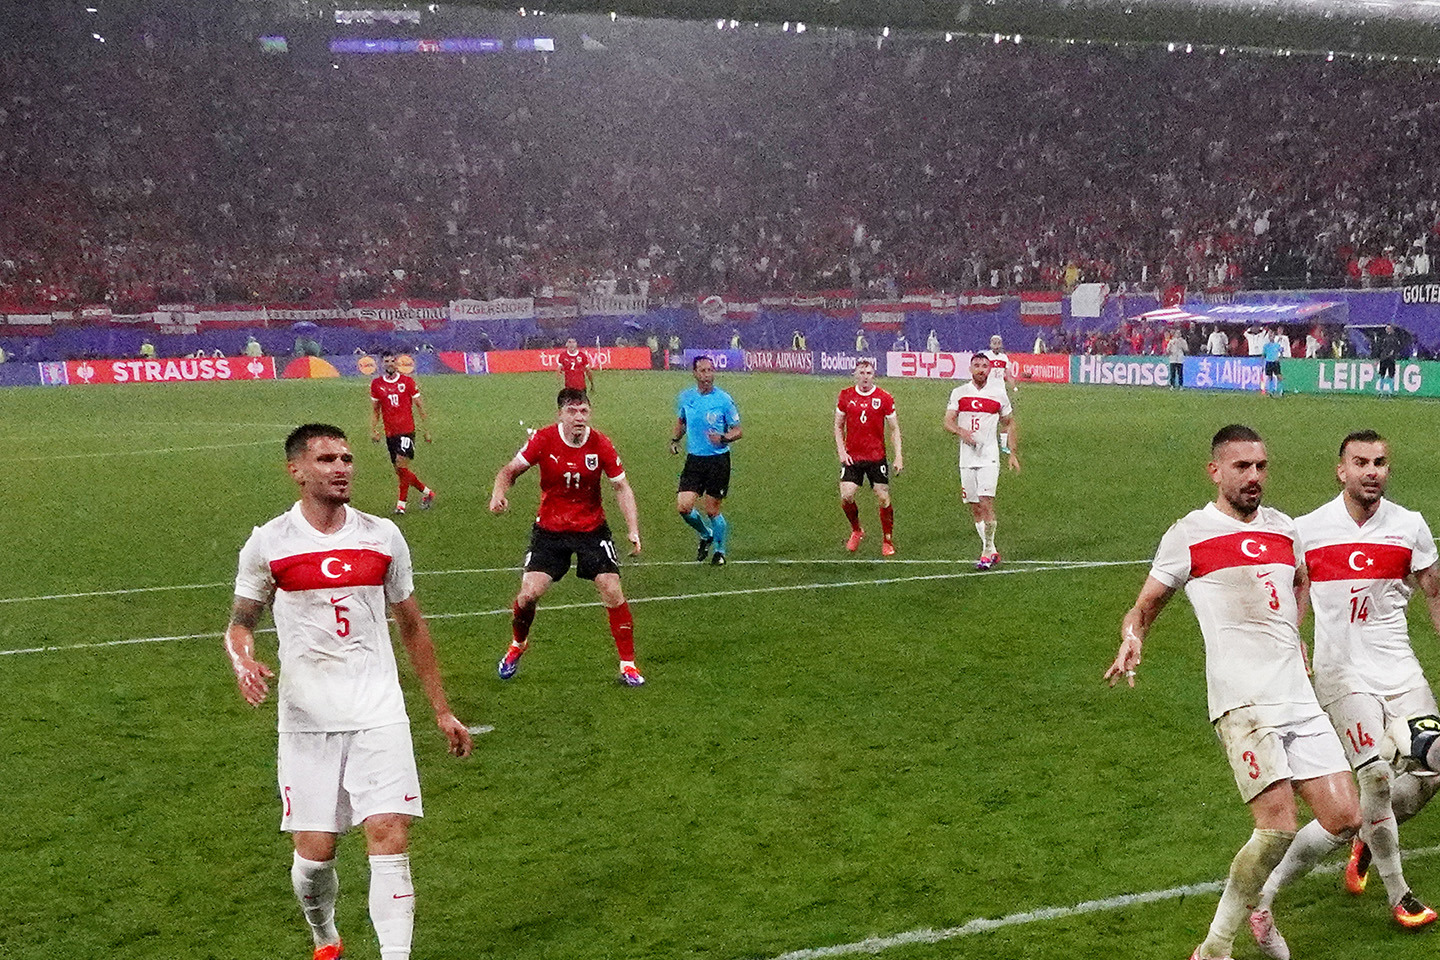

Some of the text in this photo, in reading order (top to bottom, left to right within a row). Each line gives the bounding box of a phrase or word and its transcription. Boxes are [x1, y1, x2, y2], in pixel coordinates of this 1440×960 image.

[113, 359, 231, 381] STRAUSS
[745, 352, 811, 370] QATAR AIRWAYS
[821, 351, 877, 370] Bookingcom
[1080, 354, 1168, 386] Hisense
[1223, 359, 1277, 390] Alipa
[388, 394, 399, 406] 10
[860, 410, 867, 424] 6
[971, 418, 980, 431] 15
[401, 437, 411, 449] 10
[563, 471, 581, 489] 11
[1264, 581, 1280, 611] 3
[1350, 596, 1369, 623] 14
[334, 606, 350, 638] 5
[1346, 722, 1375, 753] 14
[1242, 750, 1261, 779] 3
